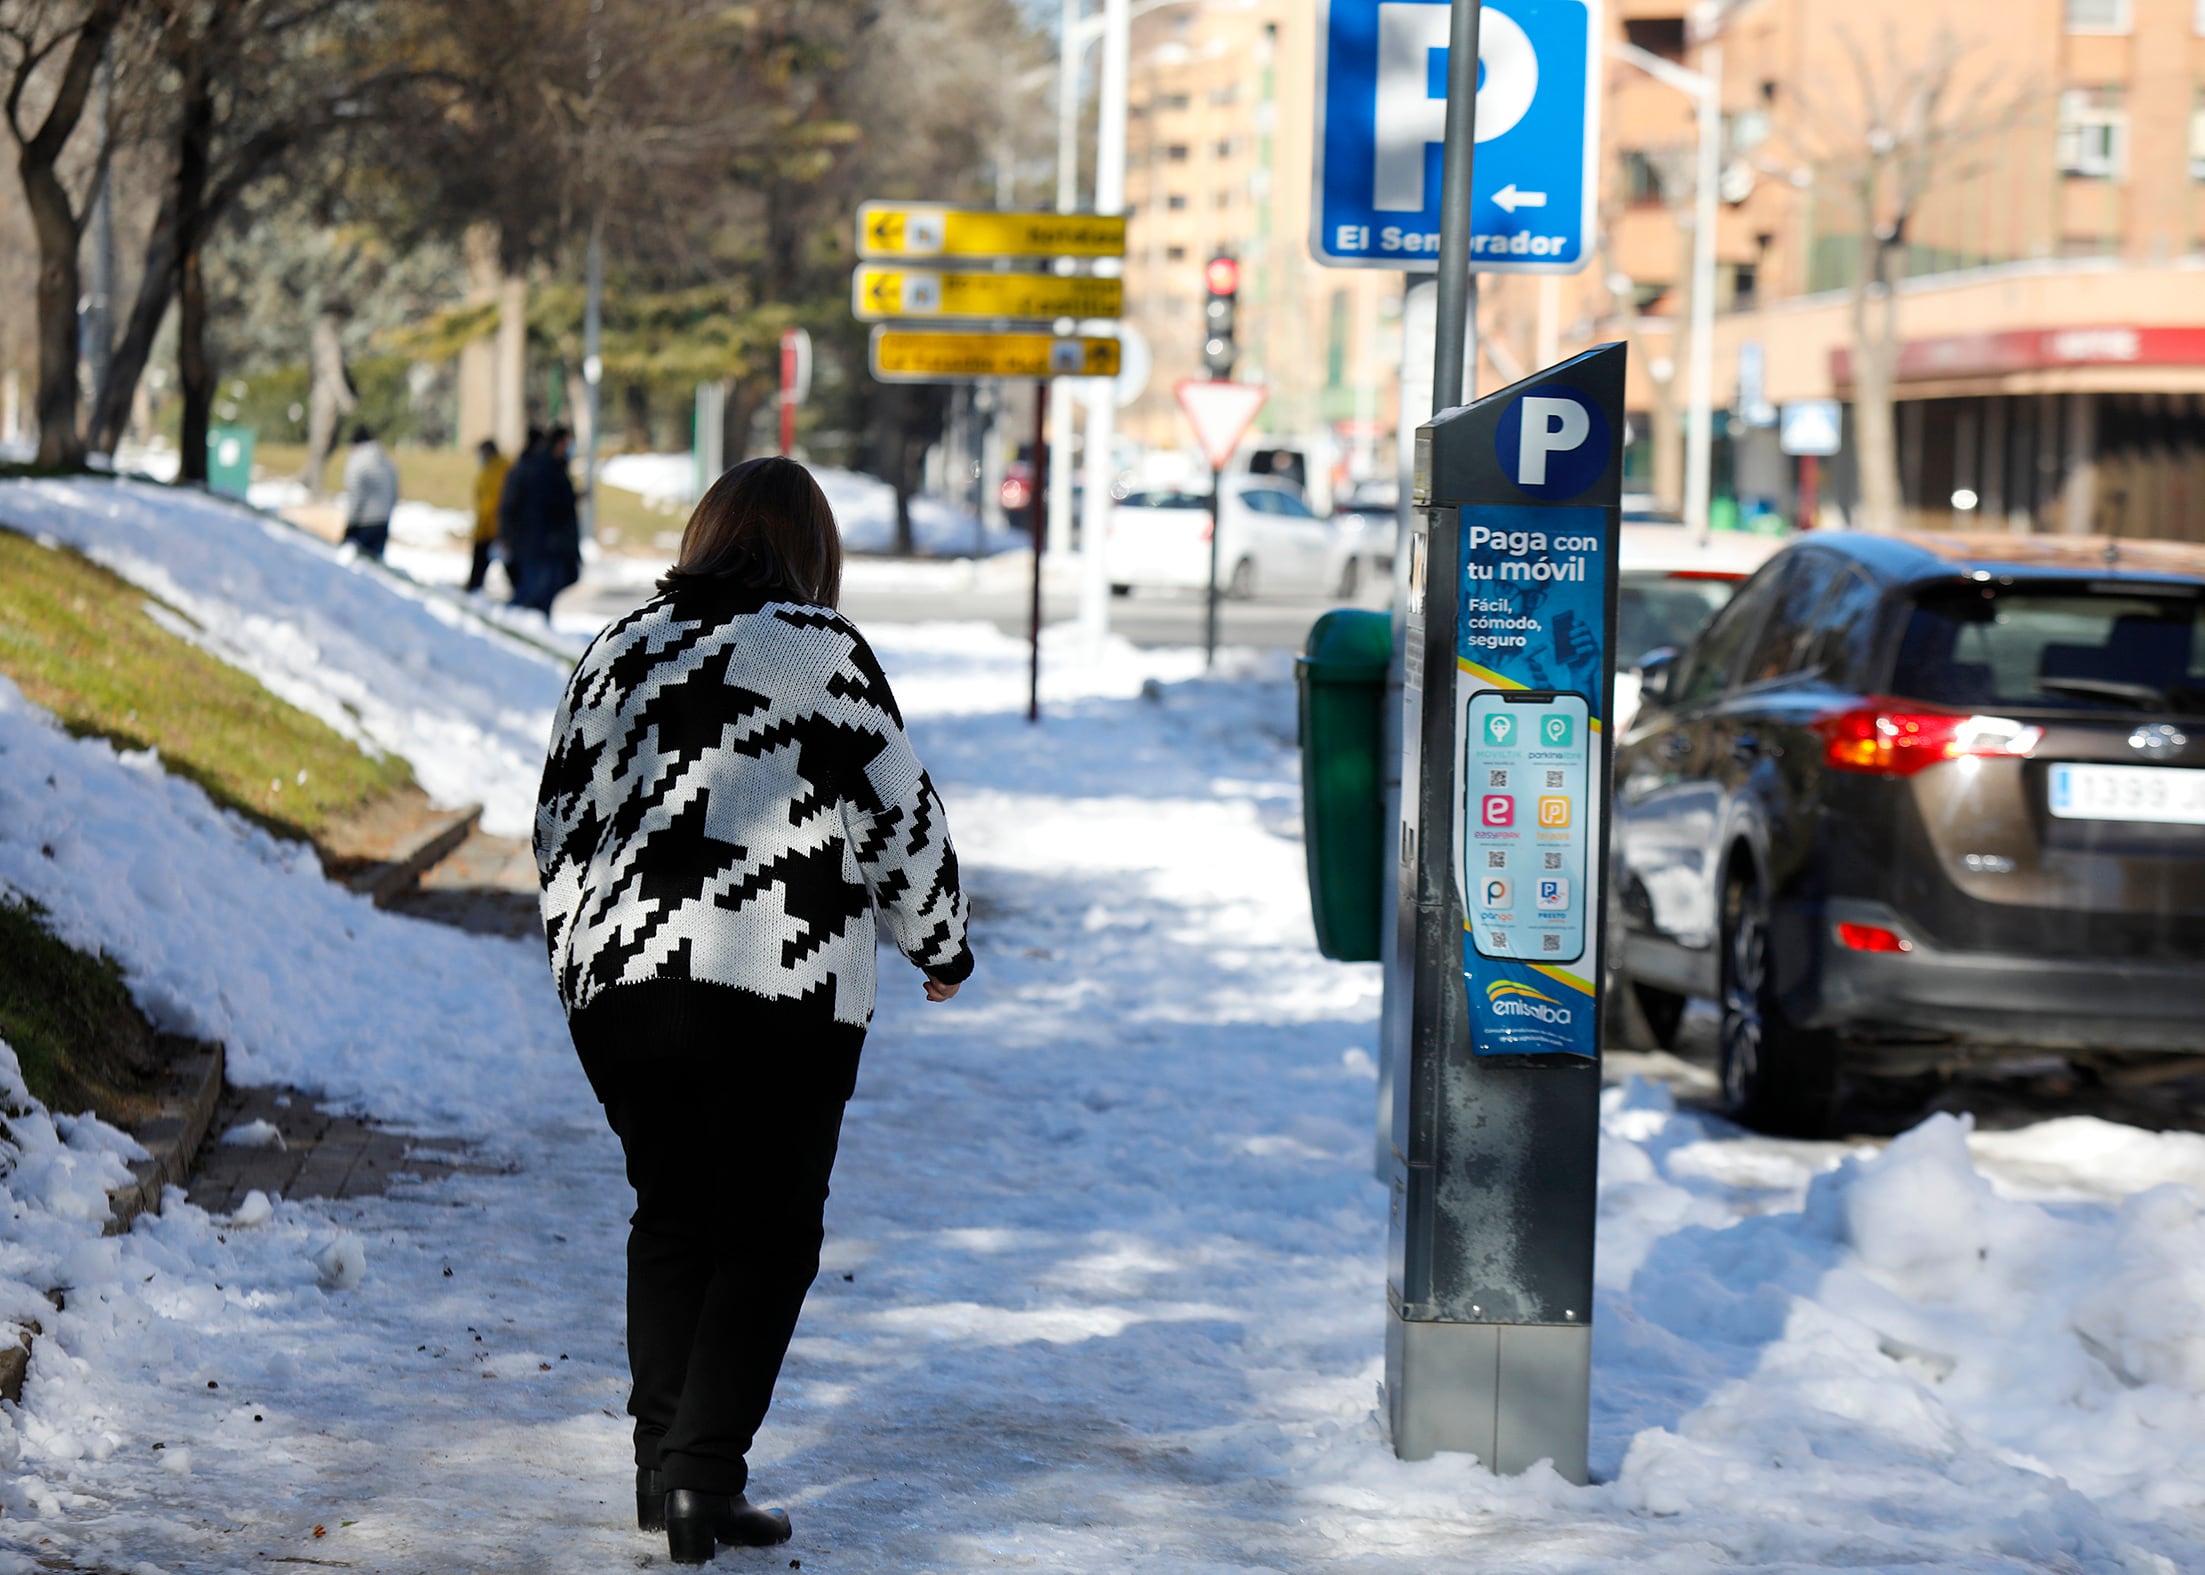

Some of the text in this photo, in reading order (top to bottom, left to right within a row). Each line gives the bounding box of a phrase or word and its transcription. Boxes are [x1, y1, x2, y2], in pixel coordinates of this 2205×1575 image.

[1373, 2, 1539, 212] P
[1336, 225, 1369, 252] El
[1518, 396, 1590, 485] P
[1468, 525, 1598, 557] Paga con
[1467, 556, 1585, 581] tu móvil
[1468, 598, 1512, 614] Fácil,
[1468, 615, 1542, 632] cómodo,
[1468, 634, 1527, 650] seguro
[1491, 999, 1572, 1024] emisalba
